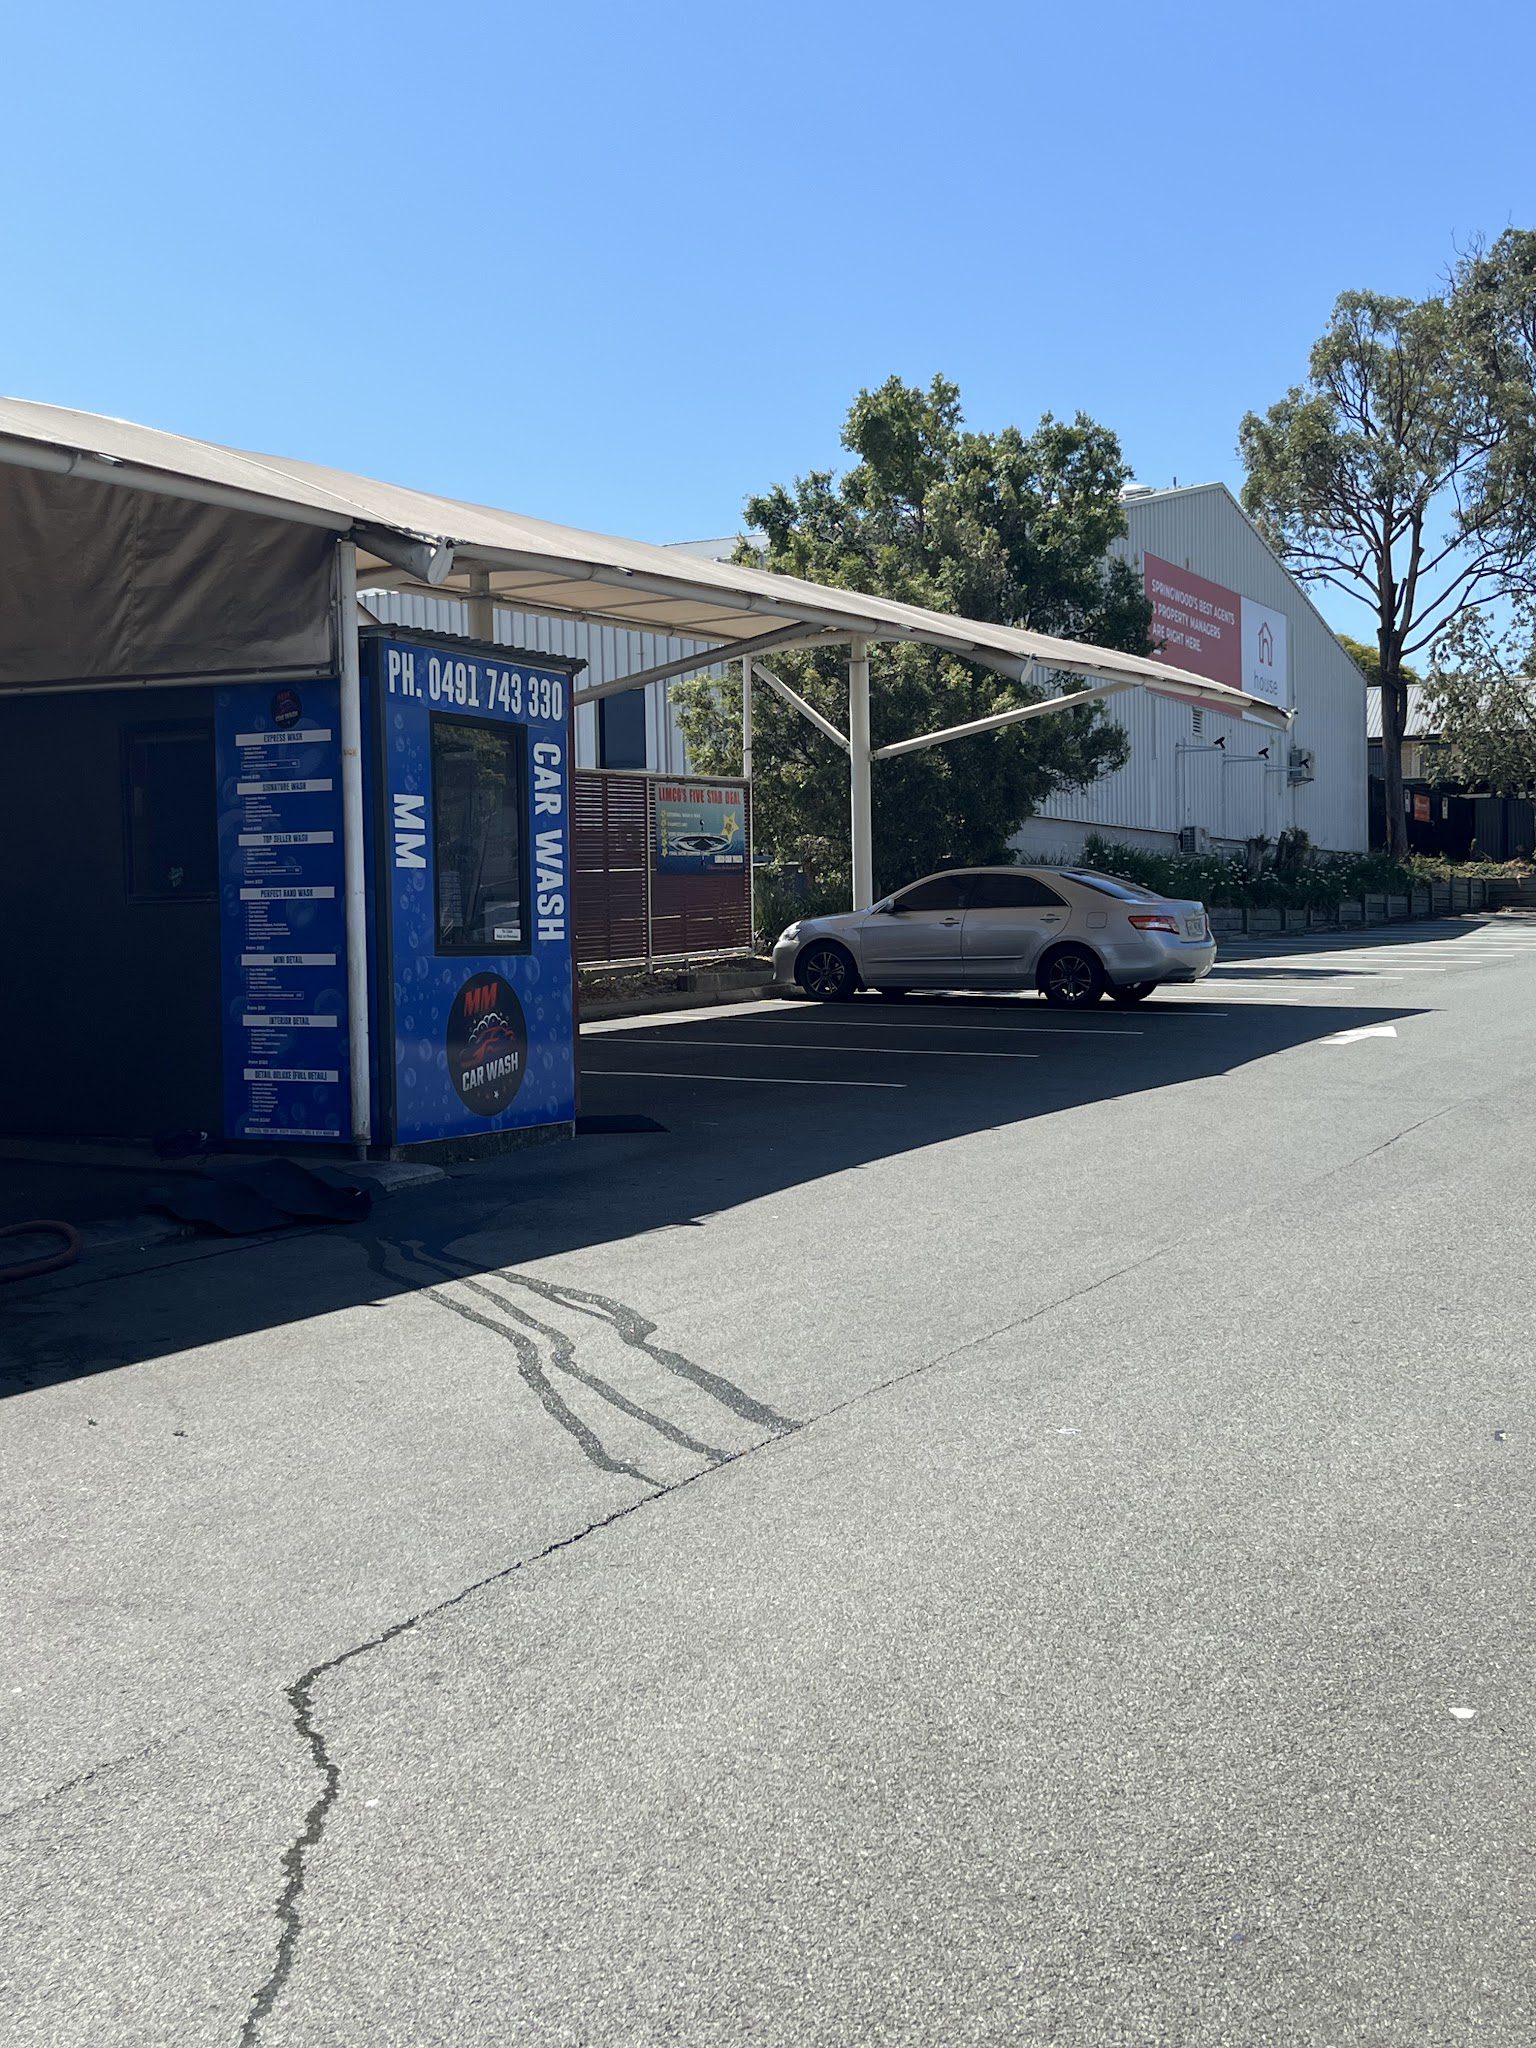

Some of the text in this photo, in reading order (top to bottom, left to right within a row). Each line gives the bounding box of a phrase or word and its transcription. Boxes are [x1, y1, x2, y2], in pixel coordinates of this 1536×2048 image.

[1151, 579, 1235, 626] SPRINGWOOD'S BEST AGENTS
[1158, 604, 1190, 627] PROPERTY
[1190, 617, 1221, 639] MANAGERS
[1152, 623, 1166, 639] ARE
[1166, 628, 1185, 646] RIGHT
[388, 648, 563, 721] PH. 0491 743 330
[1253, 671, 1278, 695] house
[264, 732, 303, 743] EXPRESS WASH
[263, 781, 306, 792] SIGNATURE WASH
[658, 786, 741, 805] LIMCO'S FIVE STAR DEAL
[263, 833, 308, 843] TOP SELLER WASH
[392, 793, 428, 869] MM
[532, 741, 566, 941] CAR WASH
[261, 888, 313, 898] PERFECT HAND WASH
[273, 955, 303, 964] MINI DETAIL
[464, 982, 498, 1016] MM
[269, 1017, 310, 1025] INTERIOR DETAIL
[255, 1070, 272, 1079] DETAIL
[461, 1052, 519, 1093] CAR WASH
